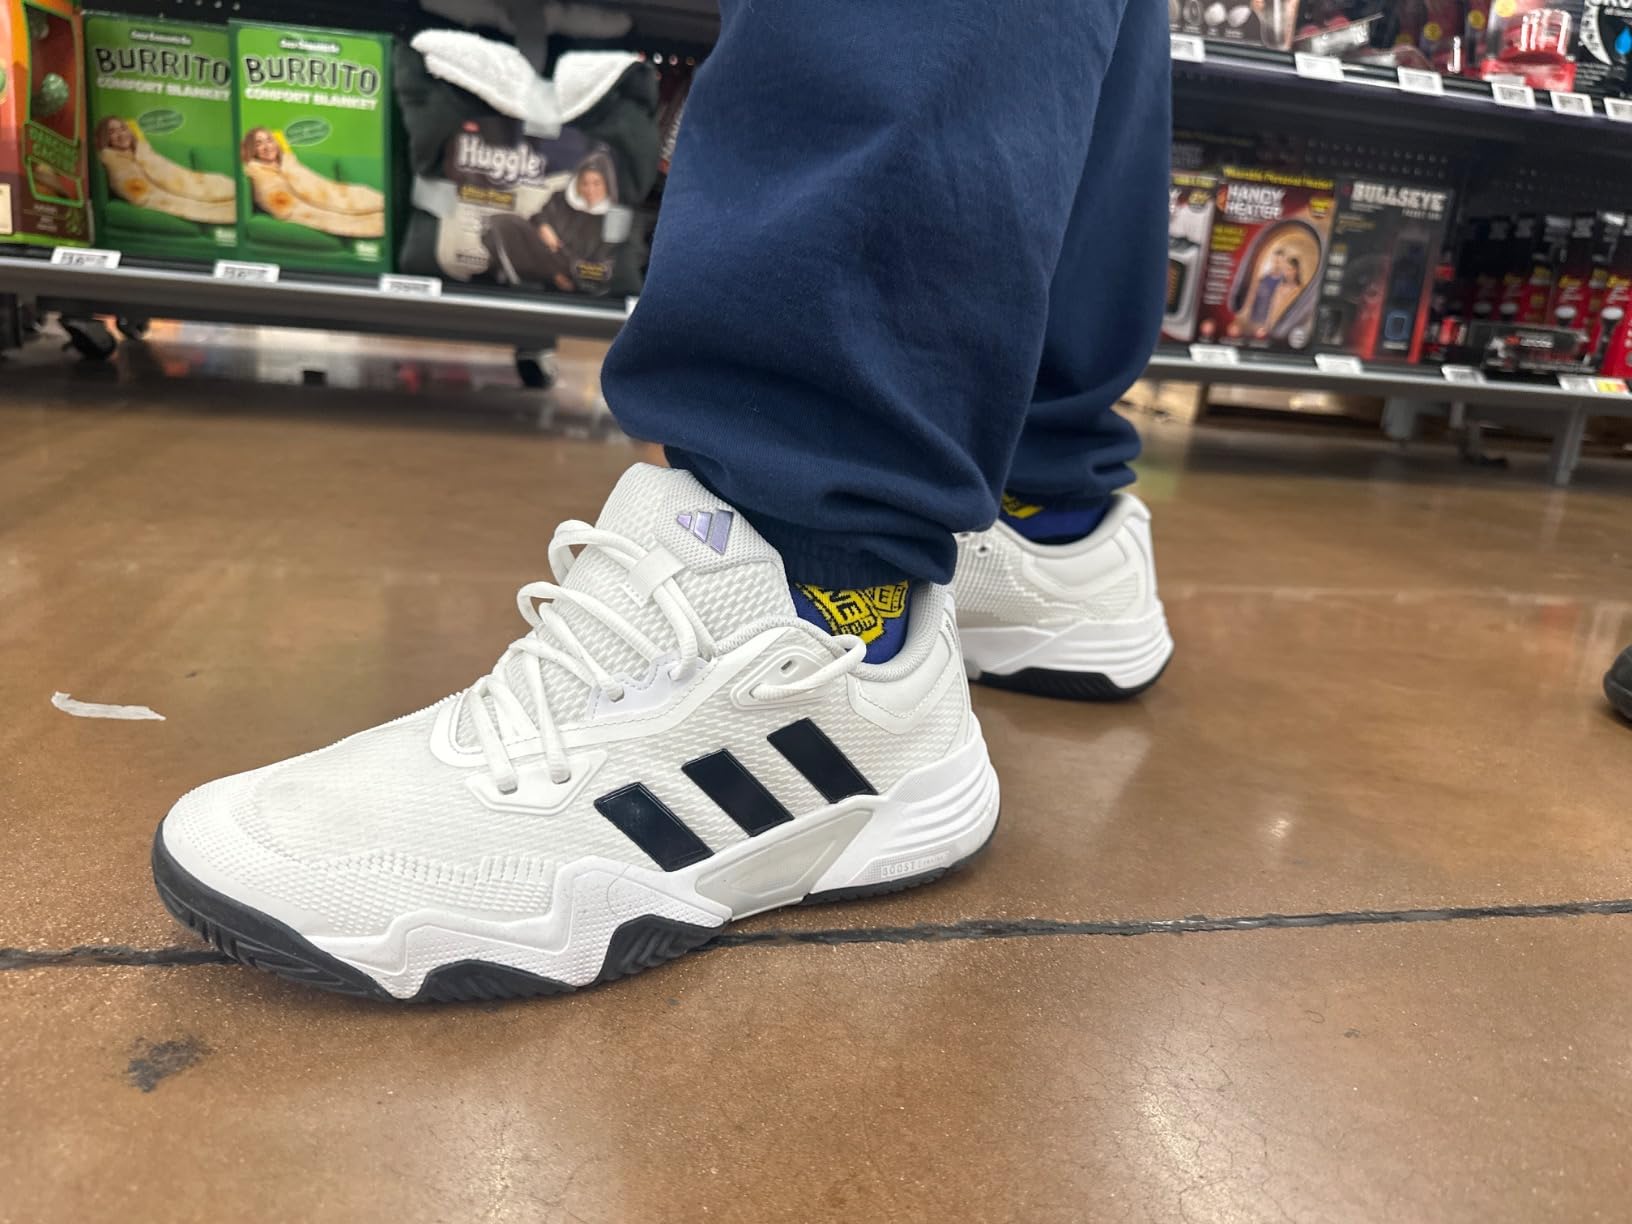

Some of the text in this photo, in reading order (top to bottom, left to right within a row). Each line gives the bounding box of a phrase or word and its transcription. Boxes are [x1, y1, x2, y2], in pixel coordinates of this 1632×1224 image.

[94, 47, 231, 87] BURRITO
[244, 56, 381, 96] BURRITO
[166, 83, 230, 101] BLANKET
[245, 87, 377, 110] COMFORT BLANKET
[457, 134, 542, 181] Huggle
[1227, 184, 1286, 206] HANDY
[1351, 181, 1448, 212] BULLSEYE
[1225, 201, 1284, 219] HEATER
